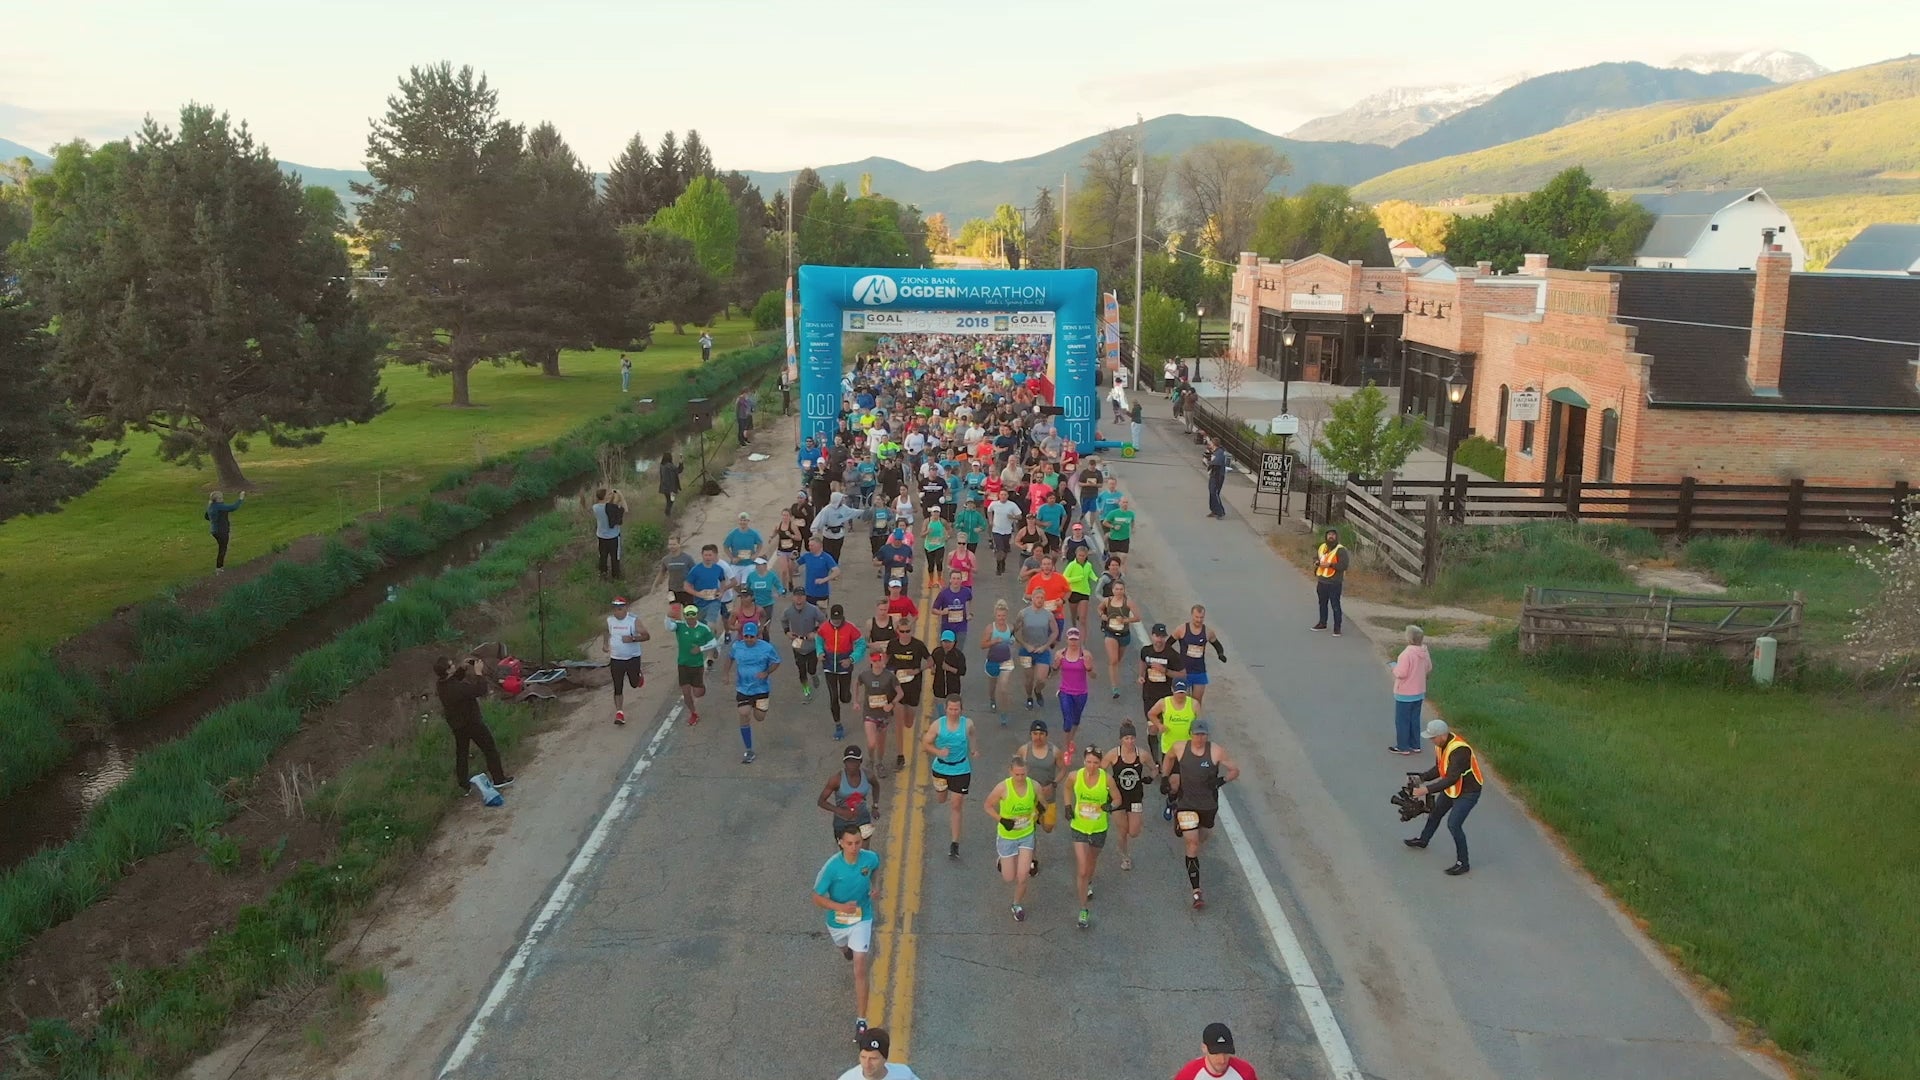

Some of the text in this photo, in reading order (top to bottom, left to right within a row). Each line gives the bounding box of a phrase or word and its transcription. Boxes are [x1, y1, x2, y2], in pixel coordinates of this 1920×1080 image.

[867, 314, 903, 322] GOAL
[956, 317, 990, 328] 2018
[1011, 315, 1047, 324] GOAL
[807, 392, 834, 416] OGD
[1063, 395, 1091, 418] OGD
[1069, 422, 1091, 444] 13.1
